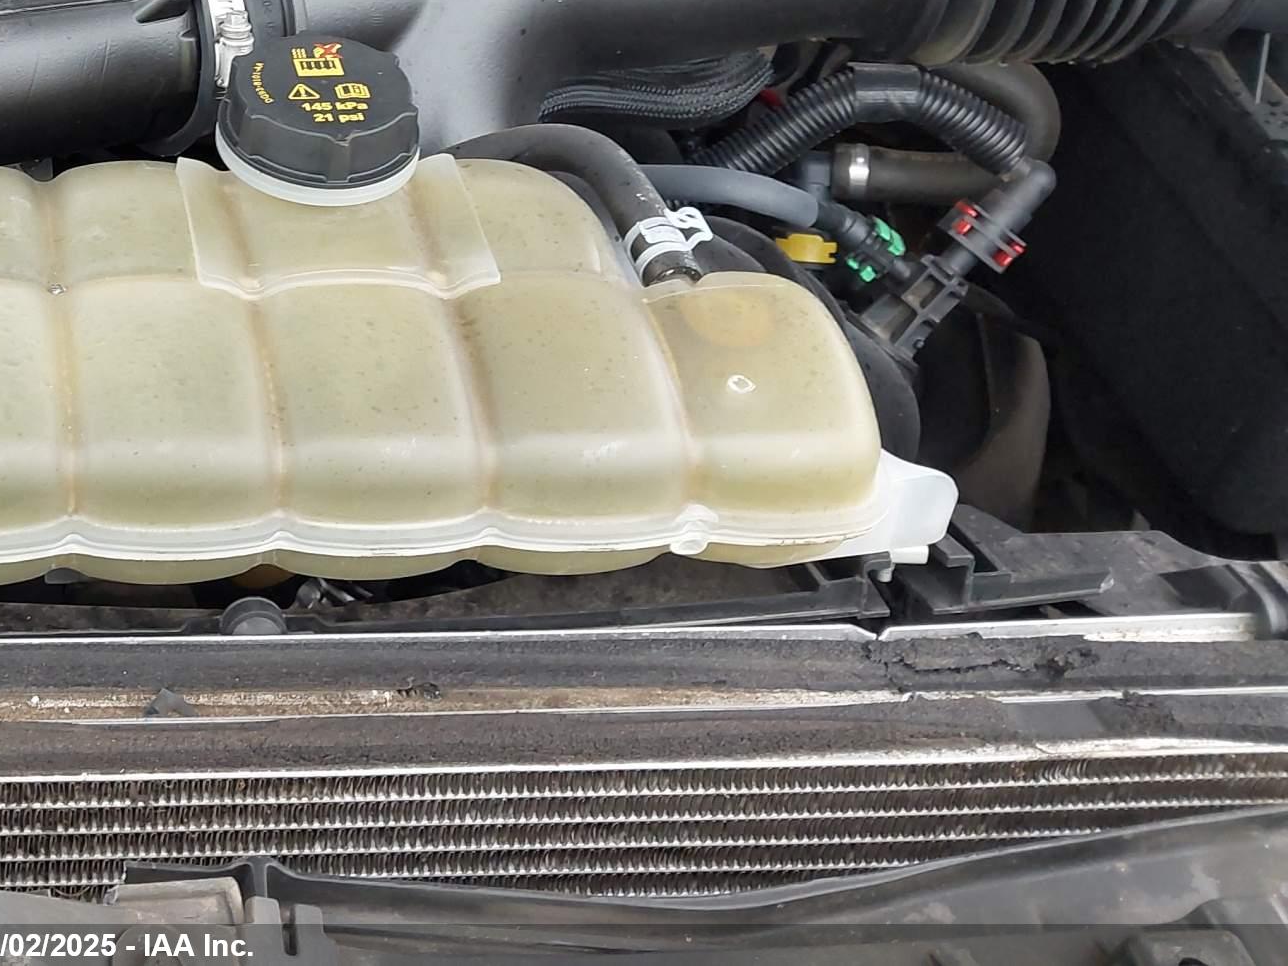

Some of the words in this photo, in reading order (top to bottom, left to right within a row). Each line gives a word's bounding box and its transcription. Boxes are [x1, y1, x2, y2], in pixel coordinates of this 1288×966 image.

[301, 101, 333, 112] 145
[335, 100, 369, 111] kPa
[313, 112, 334, 123] 21
[338, 112, 365, 124] psi
